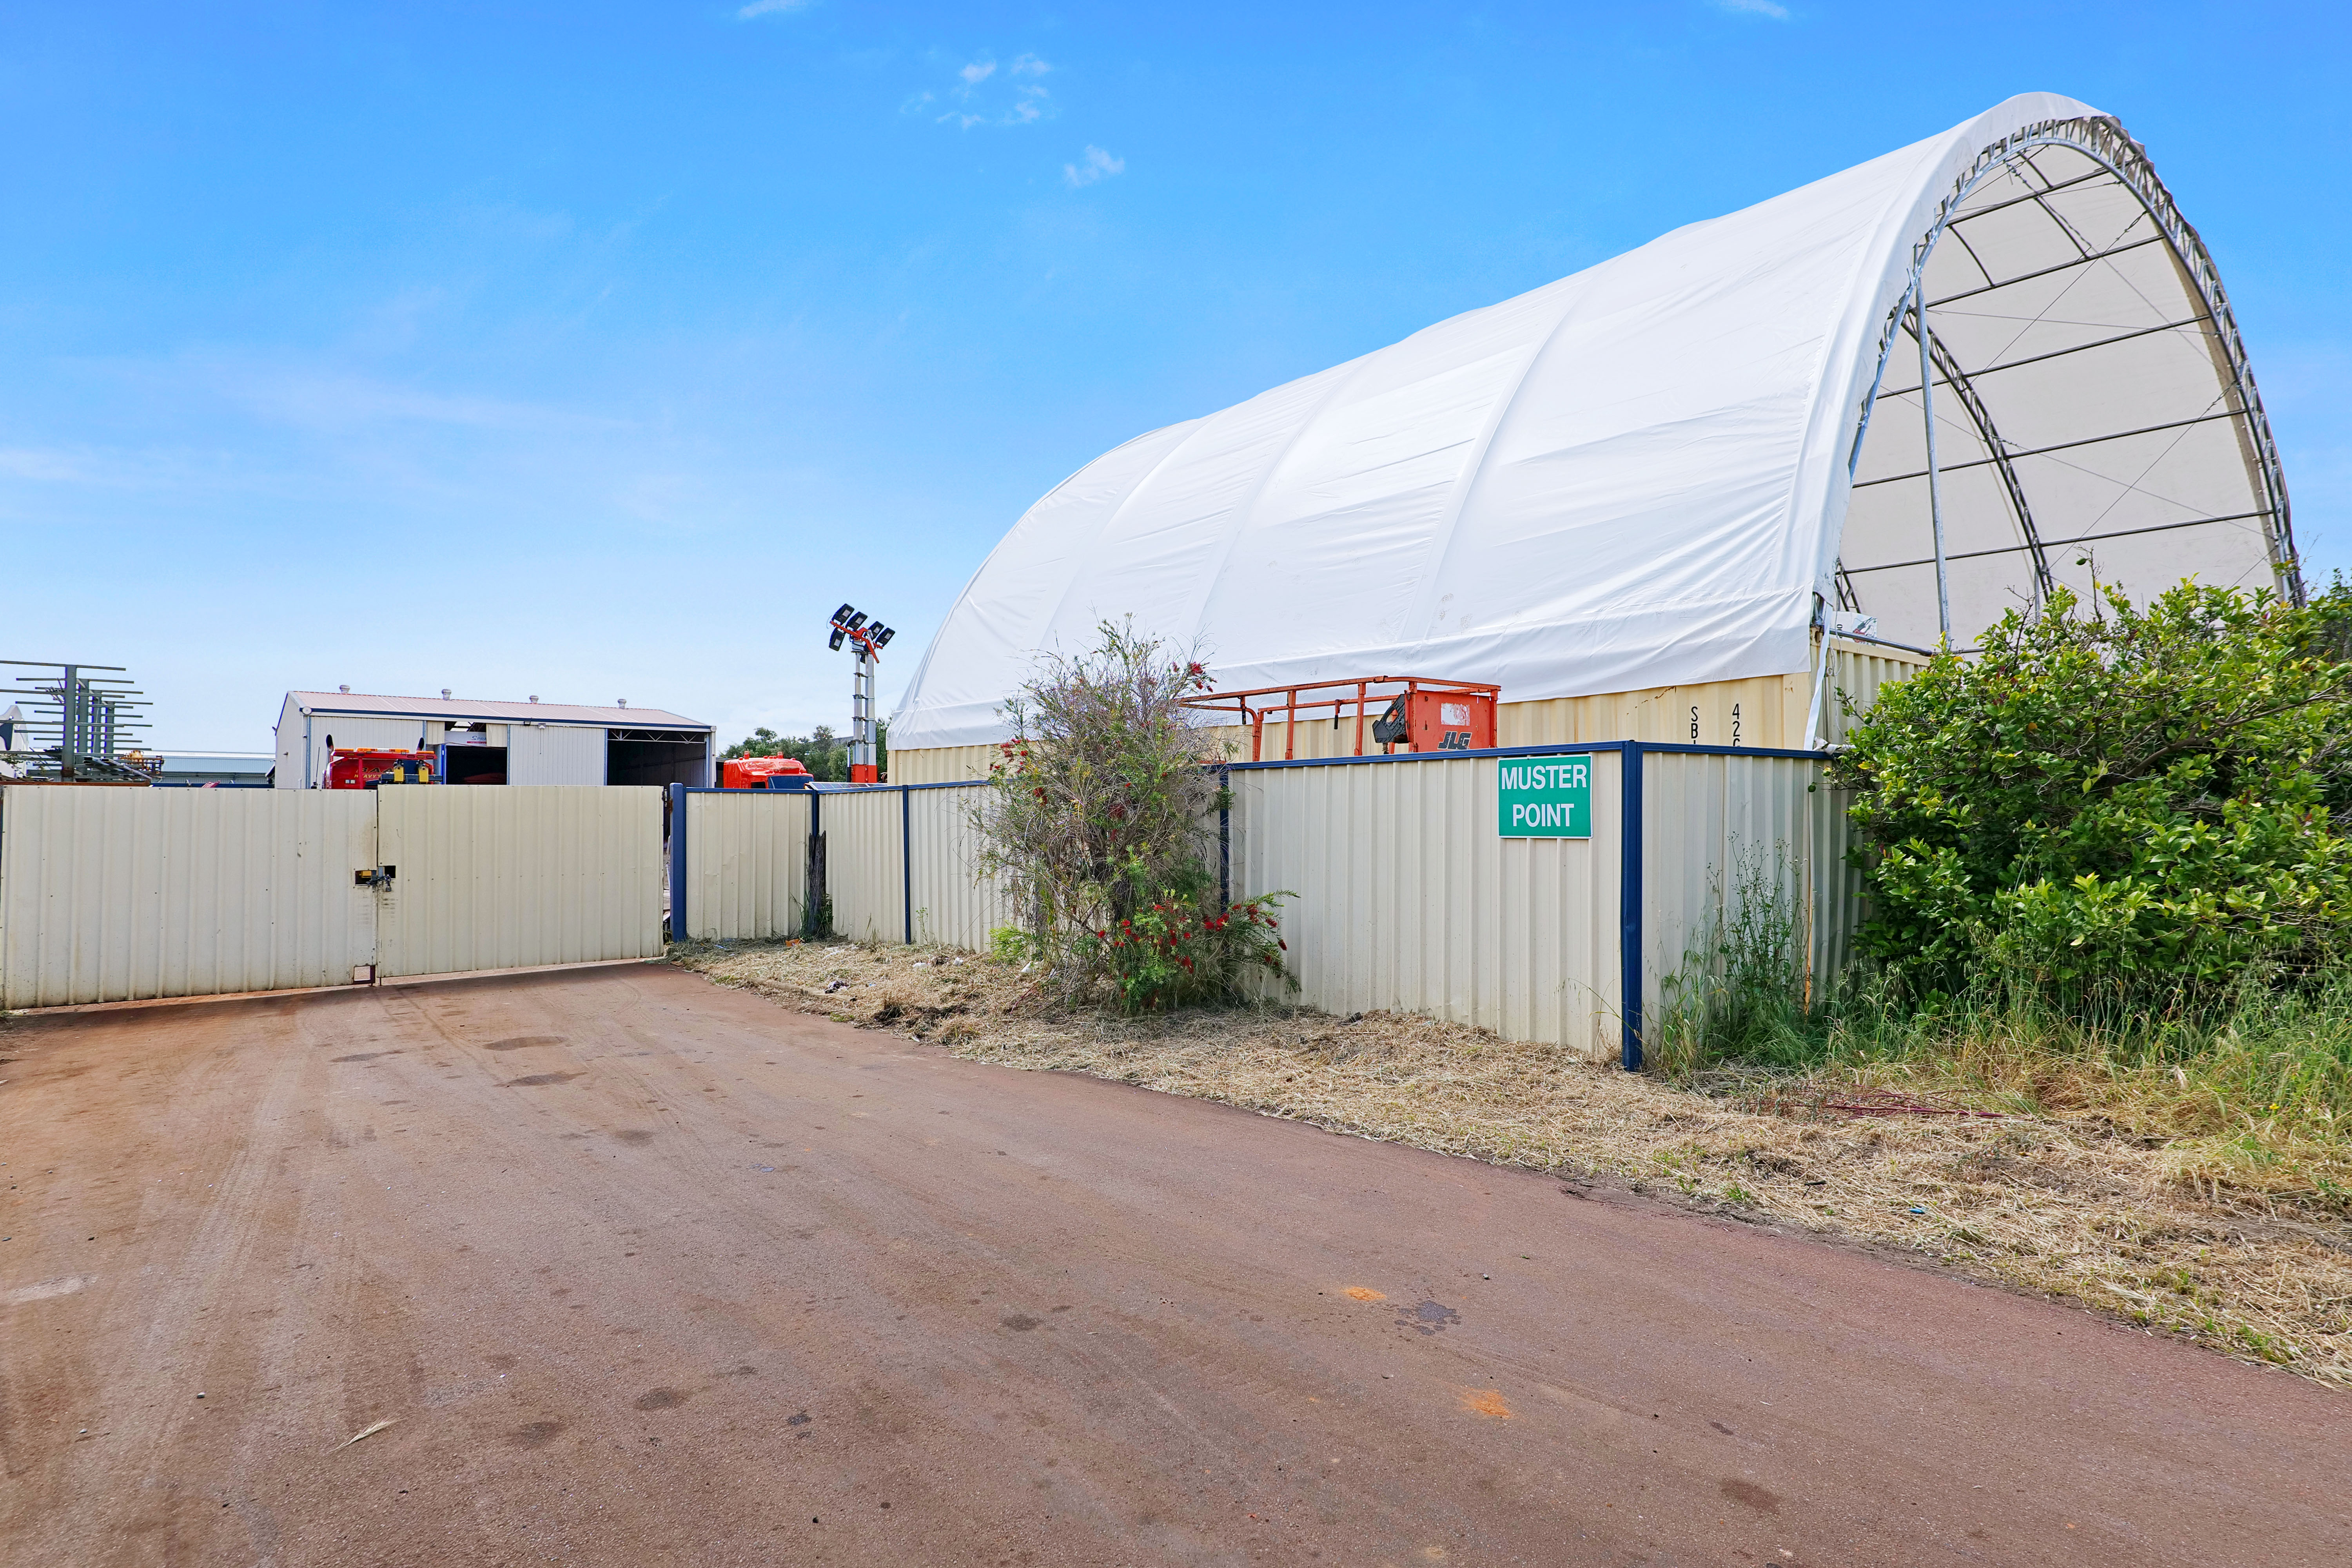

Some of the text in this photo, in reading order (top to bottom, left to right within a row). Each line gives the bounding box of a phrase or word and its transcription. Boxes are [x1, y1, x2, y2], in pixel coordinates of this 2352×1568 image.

[1437, 731, 1472, 750] JLG
[1501, 764, 1587, 789] MUSTER
[1513, 803, 1575, 827] POINT
